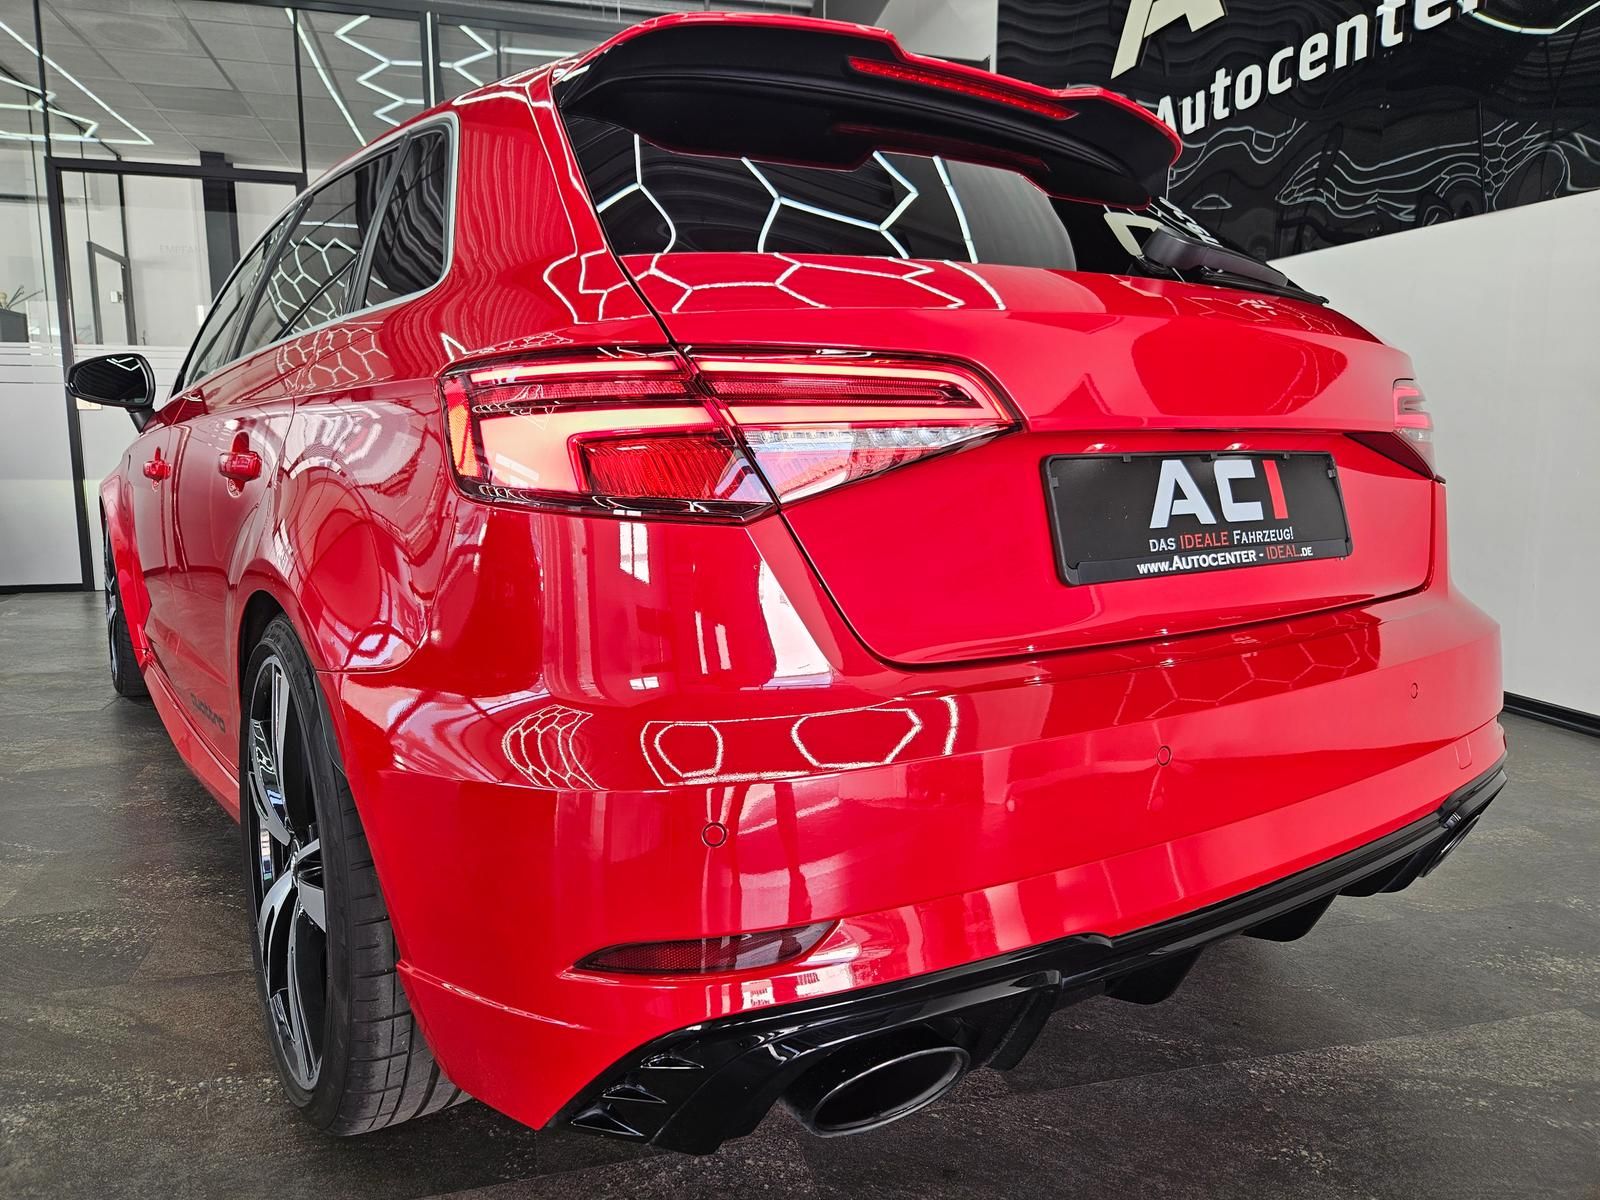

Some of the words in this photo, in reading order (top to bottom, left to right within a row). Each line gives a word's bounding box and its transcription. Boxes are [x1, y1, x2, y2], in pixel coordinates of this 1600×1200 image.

[1149, 459, 1288, 528] ACI
[1149, 538, 1176, 552] DAS
[1180, 531, 1229, 549] IDEALE
